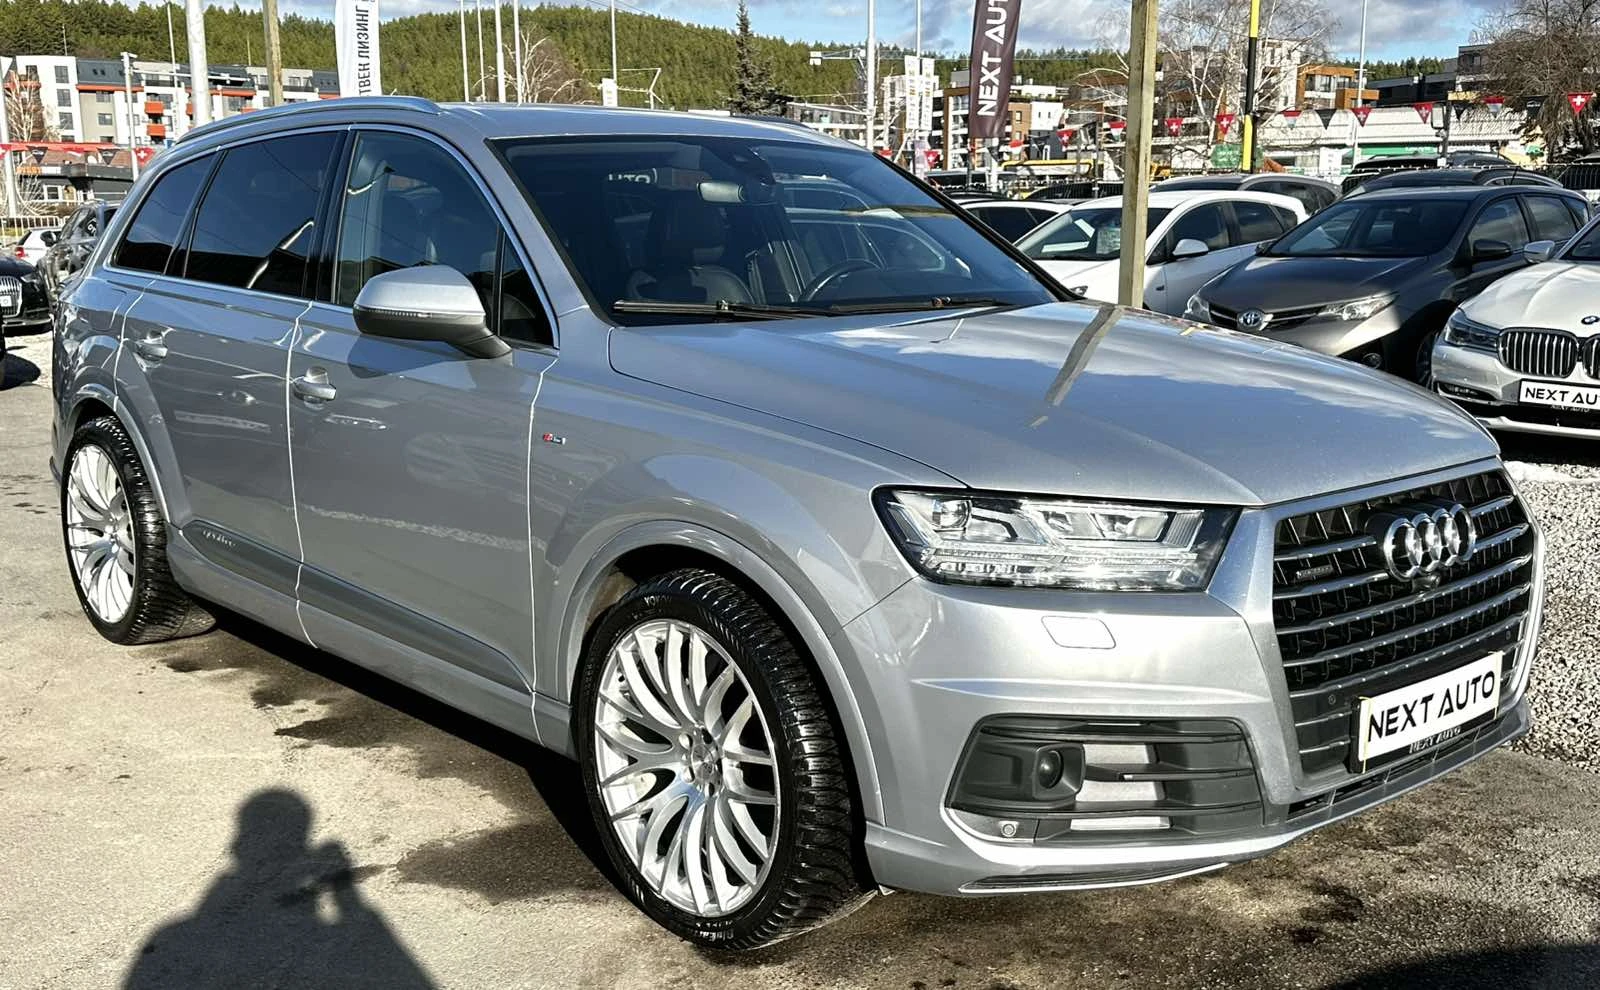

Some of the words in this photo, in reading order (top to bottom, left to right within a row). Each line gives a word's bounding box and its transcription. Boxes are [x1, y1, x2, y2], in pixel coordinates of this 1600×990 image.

[355, 5, 370, 59] ЛИЗИНГ
[357, 62, 372, 96] ТВЕН
[977, 50, 1002, 116] NEXT
[1525, 387, 1570, 402] NEXT
[1571, 392, 1600, 406] AU
[1368, 693, 1435, 742] NEXT
[1437, 670, 1495, 719] AUTO
[1409, 735, 1436, 754] NEXT
[1435, 725, 1462, 744] AUTO
